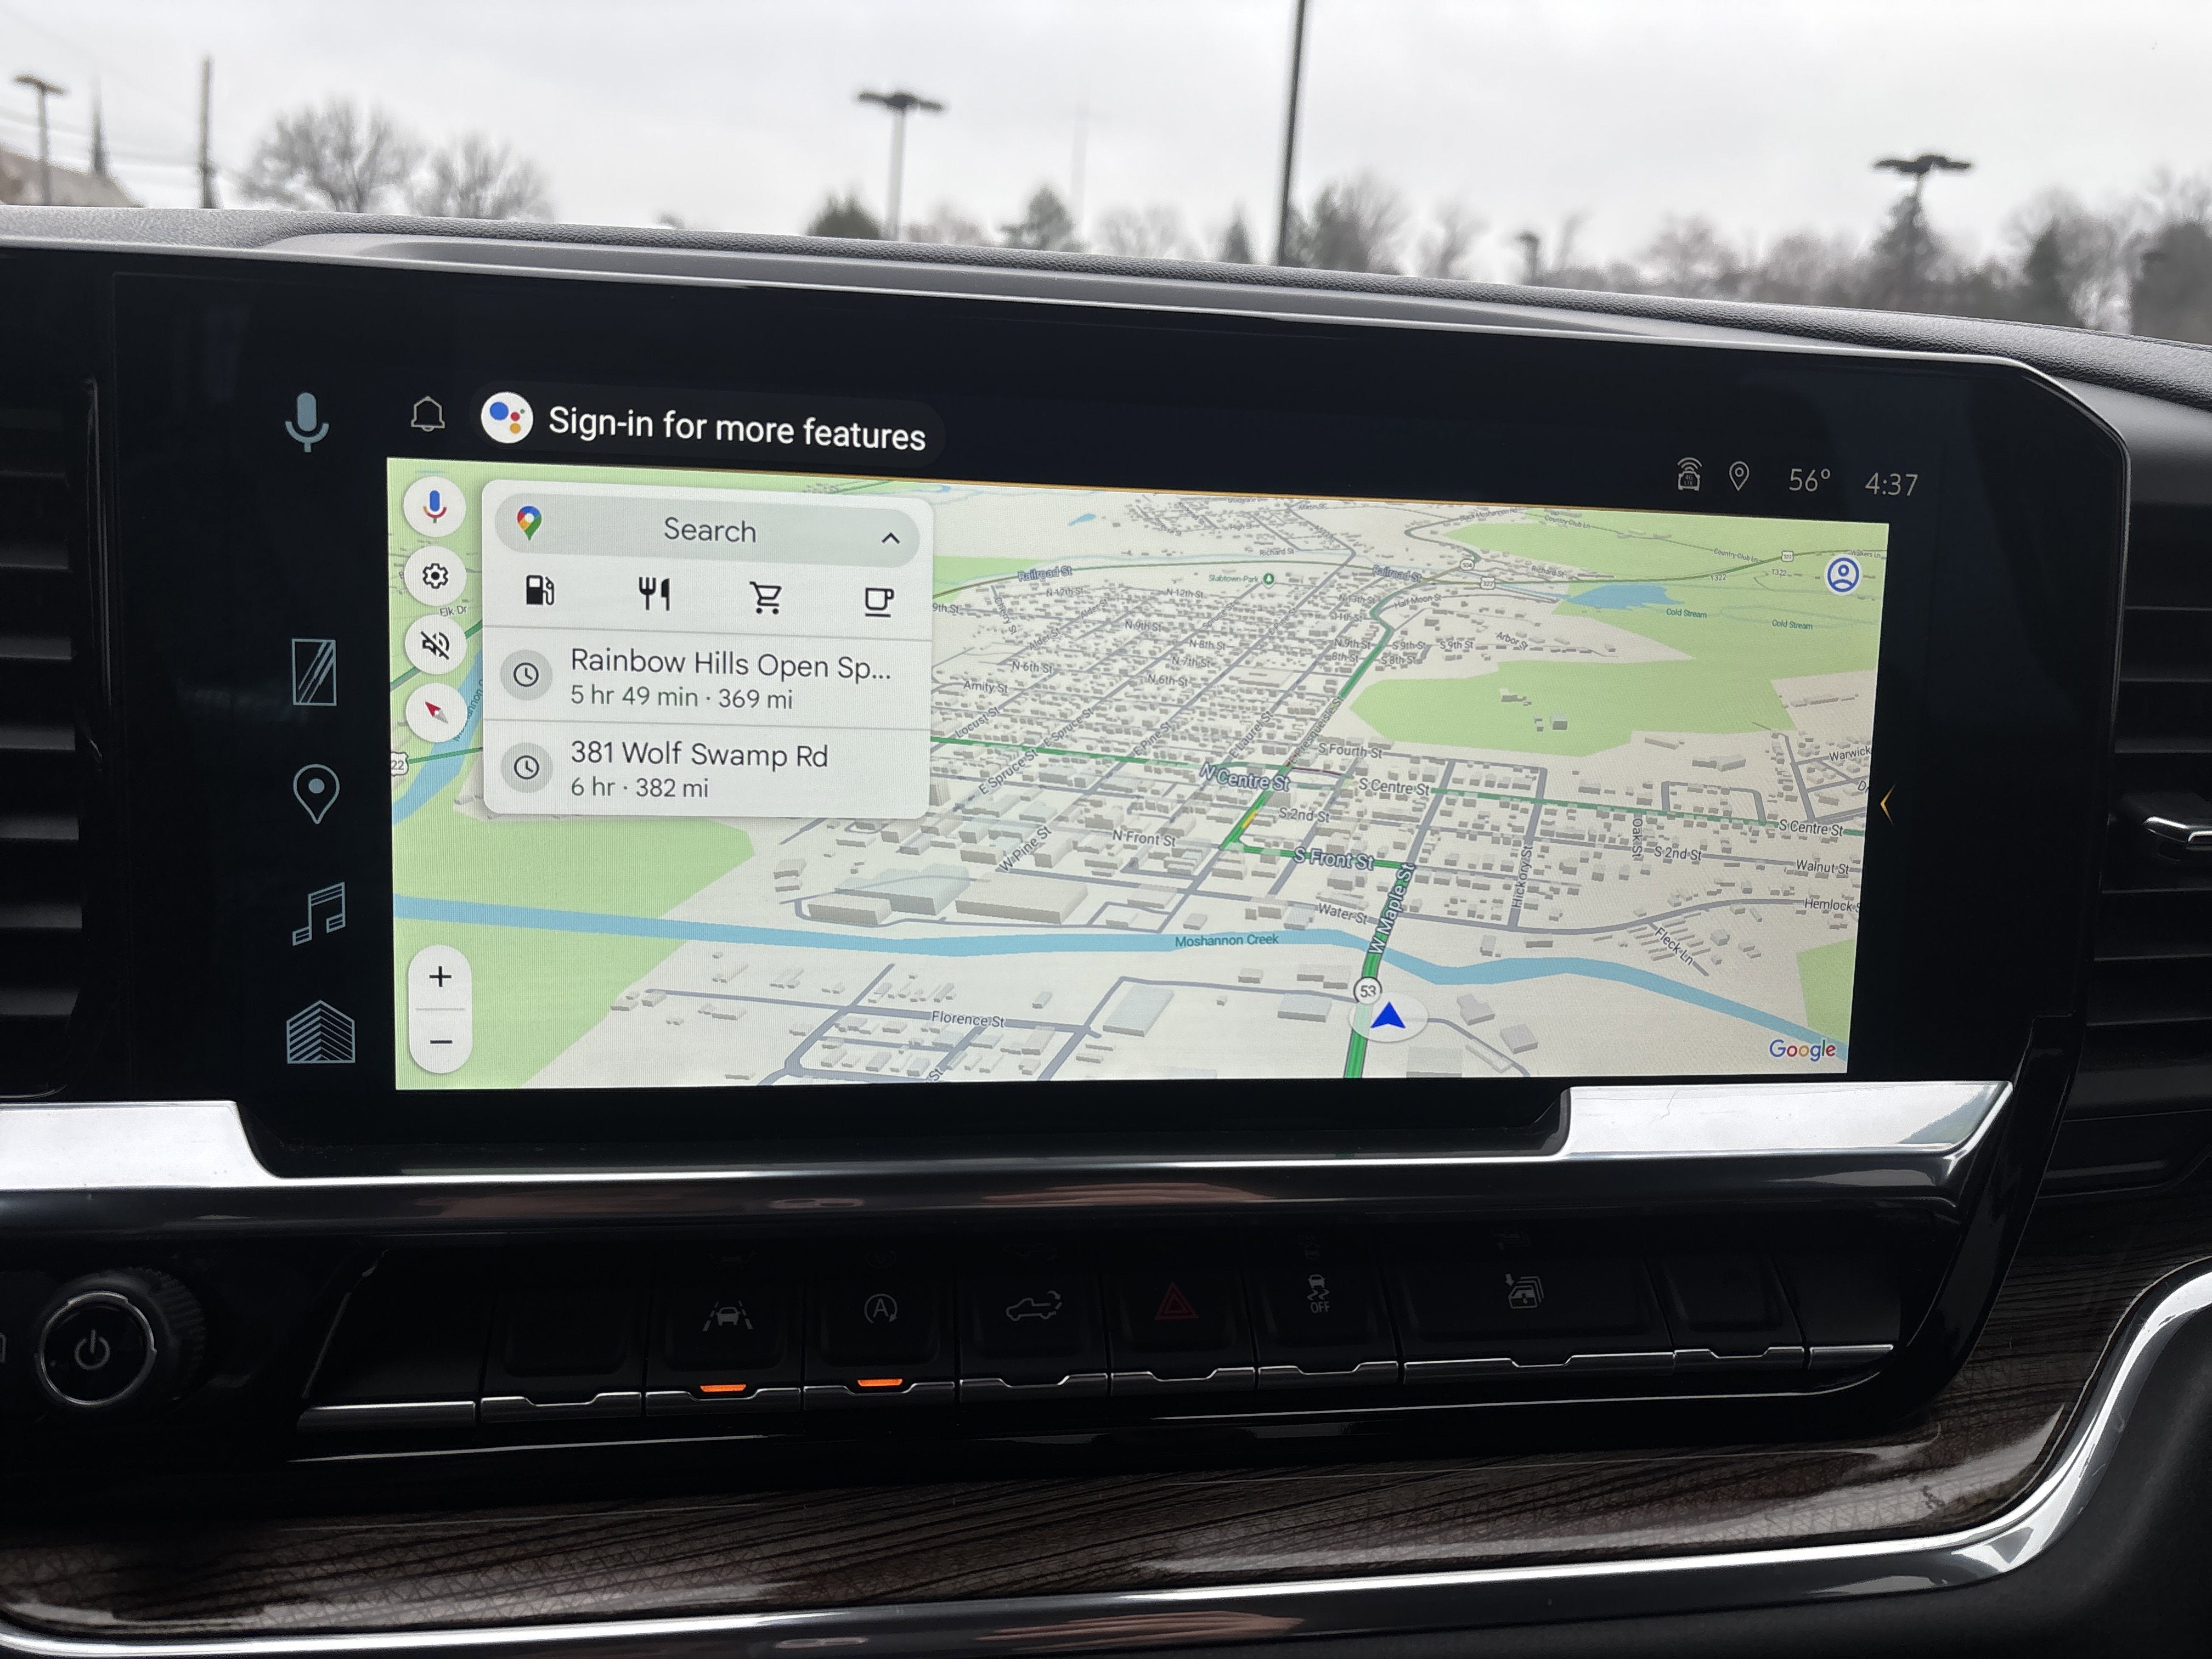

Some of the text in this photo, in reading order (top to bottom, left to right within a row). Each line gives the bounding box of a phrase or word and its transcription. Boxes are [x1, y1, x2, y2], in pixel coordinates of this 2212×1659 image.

[549, 407, 926, 451] Sign-in for more features
[1865, 472, 1918, 496] 4:37
[664, 517, 757, 543] Search
[1713, 548, 1737, 559] Country
[1737, 553, 1751, 561] Club
[1018, 566, 1073, 582] Railroad St
[1209, 574, 1259, 583] Slabtown Park
[1372, 565, 1423, 583] Railroad St
[1175, 589, 1191, 597] 12th
[1194, 590, 1204, 599] St
[457, 605, 467, 614] Dr
[933, 604, 960, 614] 9th St
[1080, 605, 1099, 619] Alder
[1666, 608, 1707, 619] Cold Stream
[1125, 620, 1162, 632] N 9th St
[1203, 609, 1224, 630] Spruce
[1772, 619, 1813, 630] Cold Stream
[1029, 628, 1061, 650] Alder St
[1189, 640, 1226, 651] N 8th St
[1334, 639, 1371, 650] N 9th St
[1398, 641, 1414, 650] 9th
[1416, 642, 1426, 651] St
[1447, 641, 1462, 650] 9th
[1464, 641, 1474, 650] St
[1496, 631, 1519, 646] Arbor
[1172, 657, 1210, 668] N 7th St
[1331, 652, 1359, 663] 8th St
[1388, 656, 1404, 665] 8th
[1406, 656, 1416, 665] St
[572, 647, 891, 685] Rainbow Hills Open Sp...
[1012, 661, 1053, 673] N 6th St
[963, 680, 1008, 694] Amity St
[1148, 674, 1188, 687] N 6th St
[571, 684, 793, 709] 5 hr 49 min 369 mi
[955, 706, 1001, 739] Locust St
[1043, 707, 1095, 747] E Spruce St
[1133, 720, 1172, 757] E Pine St
[1229, 710, 1273, 759] E Laurel St
[572, 741, 828, 772] 381 Wolf Swamp Rd
[1318, 743, 1383, 759] S Fourth St
[1829, 746, 1871, 761] Warwick
[391, 759, 405, 770] 22
[978, 748, 1039, 795] E Spruce St
[1200, 761, 1290, 792] N Centre St
[572, 776, 709, 798] 6 hr 382 mi
[1359, 778, 1430, 796] S Centre St
[1279, 808, 1330, 823] S 2nd St
[1779, 820, 1844, 837] S Centre St
[1113, 830, 1176, 847] N Front St
[1632, 818, 1643, 859] Oak St
[999, 825, 1052, 872] W Pine St
[1654, 846, 1702, 861] S 2nd St
[1293, 848, 1375, 870] S Front St
[1796, 860, 1849, 874] Walnut St
[1511, 844, 1533, 910] Hickory St
[1368, 862, 1417, 955] W Maple St
[1804, 898, 1852, 912] Hemlock
[1318, 902, 1368, 925] Water St
[1175, 933, 1279, 947] Moshannon Creek
[1655, 927, 1695, 966] Fleck Ln
[1359, 984, 1377, 997] 53
[932, 1011, 1005, 1029] Florence St
[1769, 1039, 1836, 1062] Google
[929, 1068, 944, 1081] St
[1310, 1301, 1330, 1313] OFF
